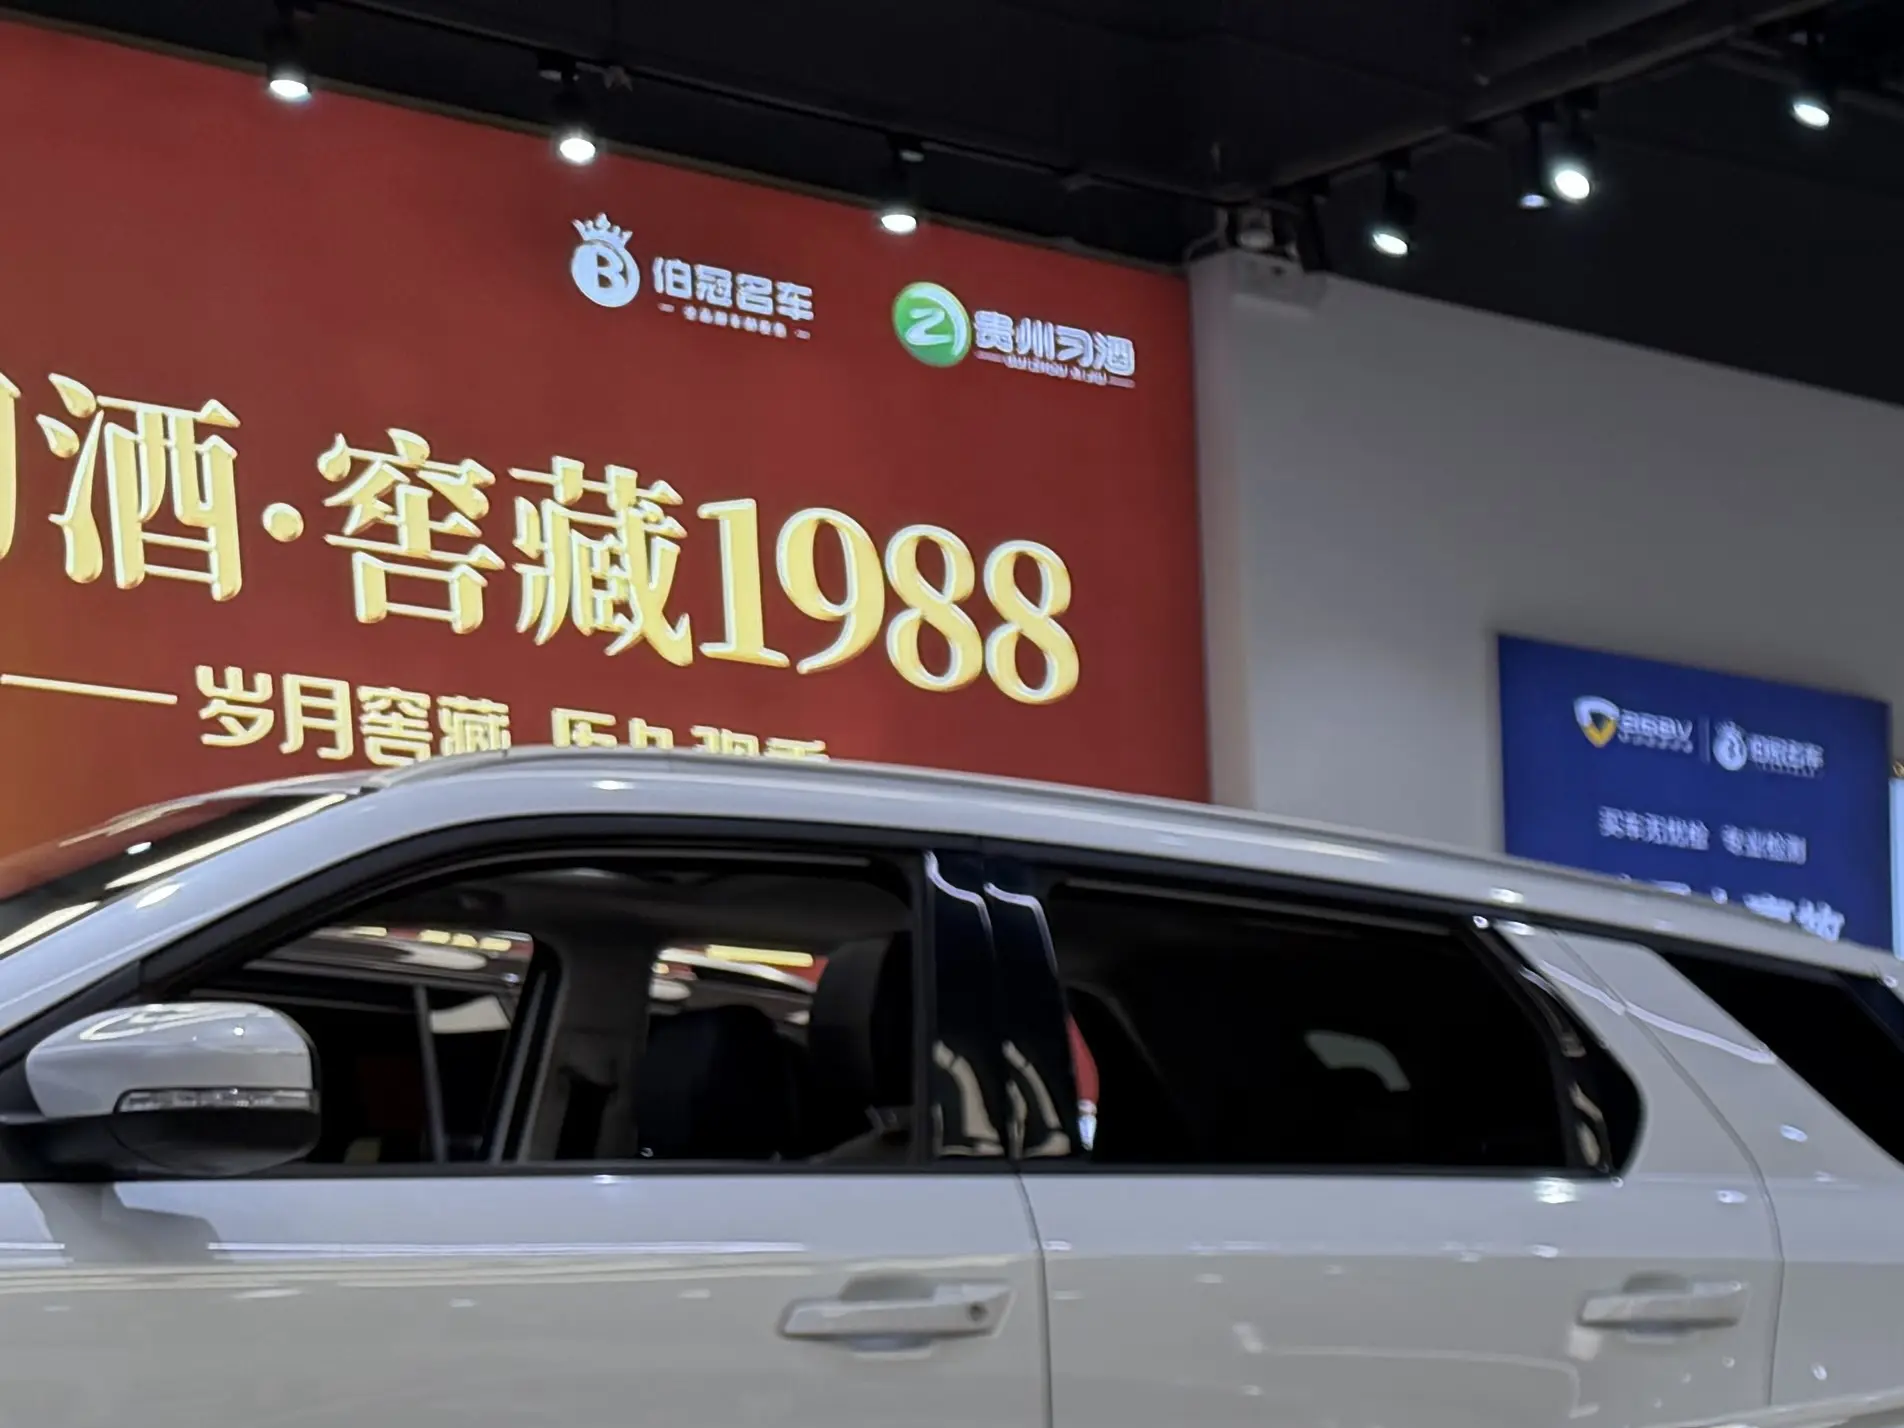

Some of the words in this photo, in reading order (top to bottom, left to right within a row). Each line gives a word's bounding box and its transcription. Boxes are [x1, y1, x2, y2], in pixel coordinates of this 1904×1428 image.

[653, 257, 814, 321] 伯冠名车
[974, 310, 1136, 377] 贵州习酒
[0, 369, 1081, 705] 酒·窖藏1988
[195, 664, 512, 765] 岁月窖藏
